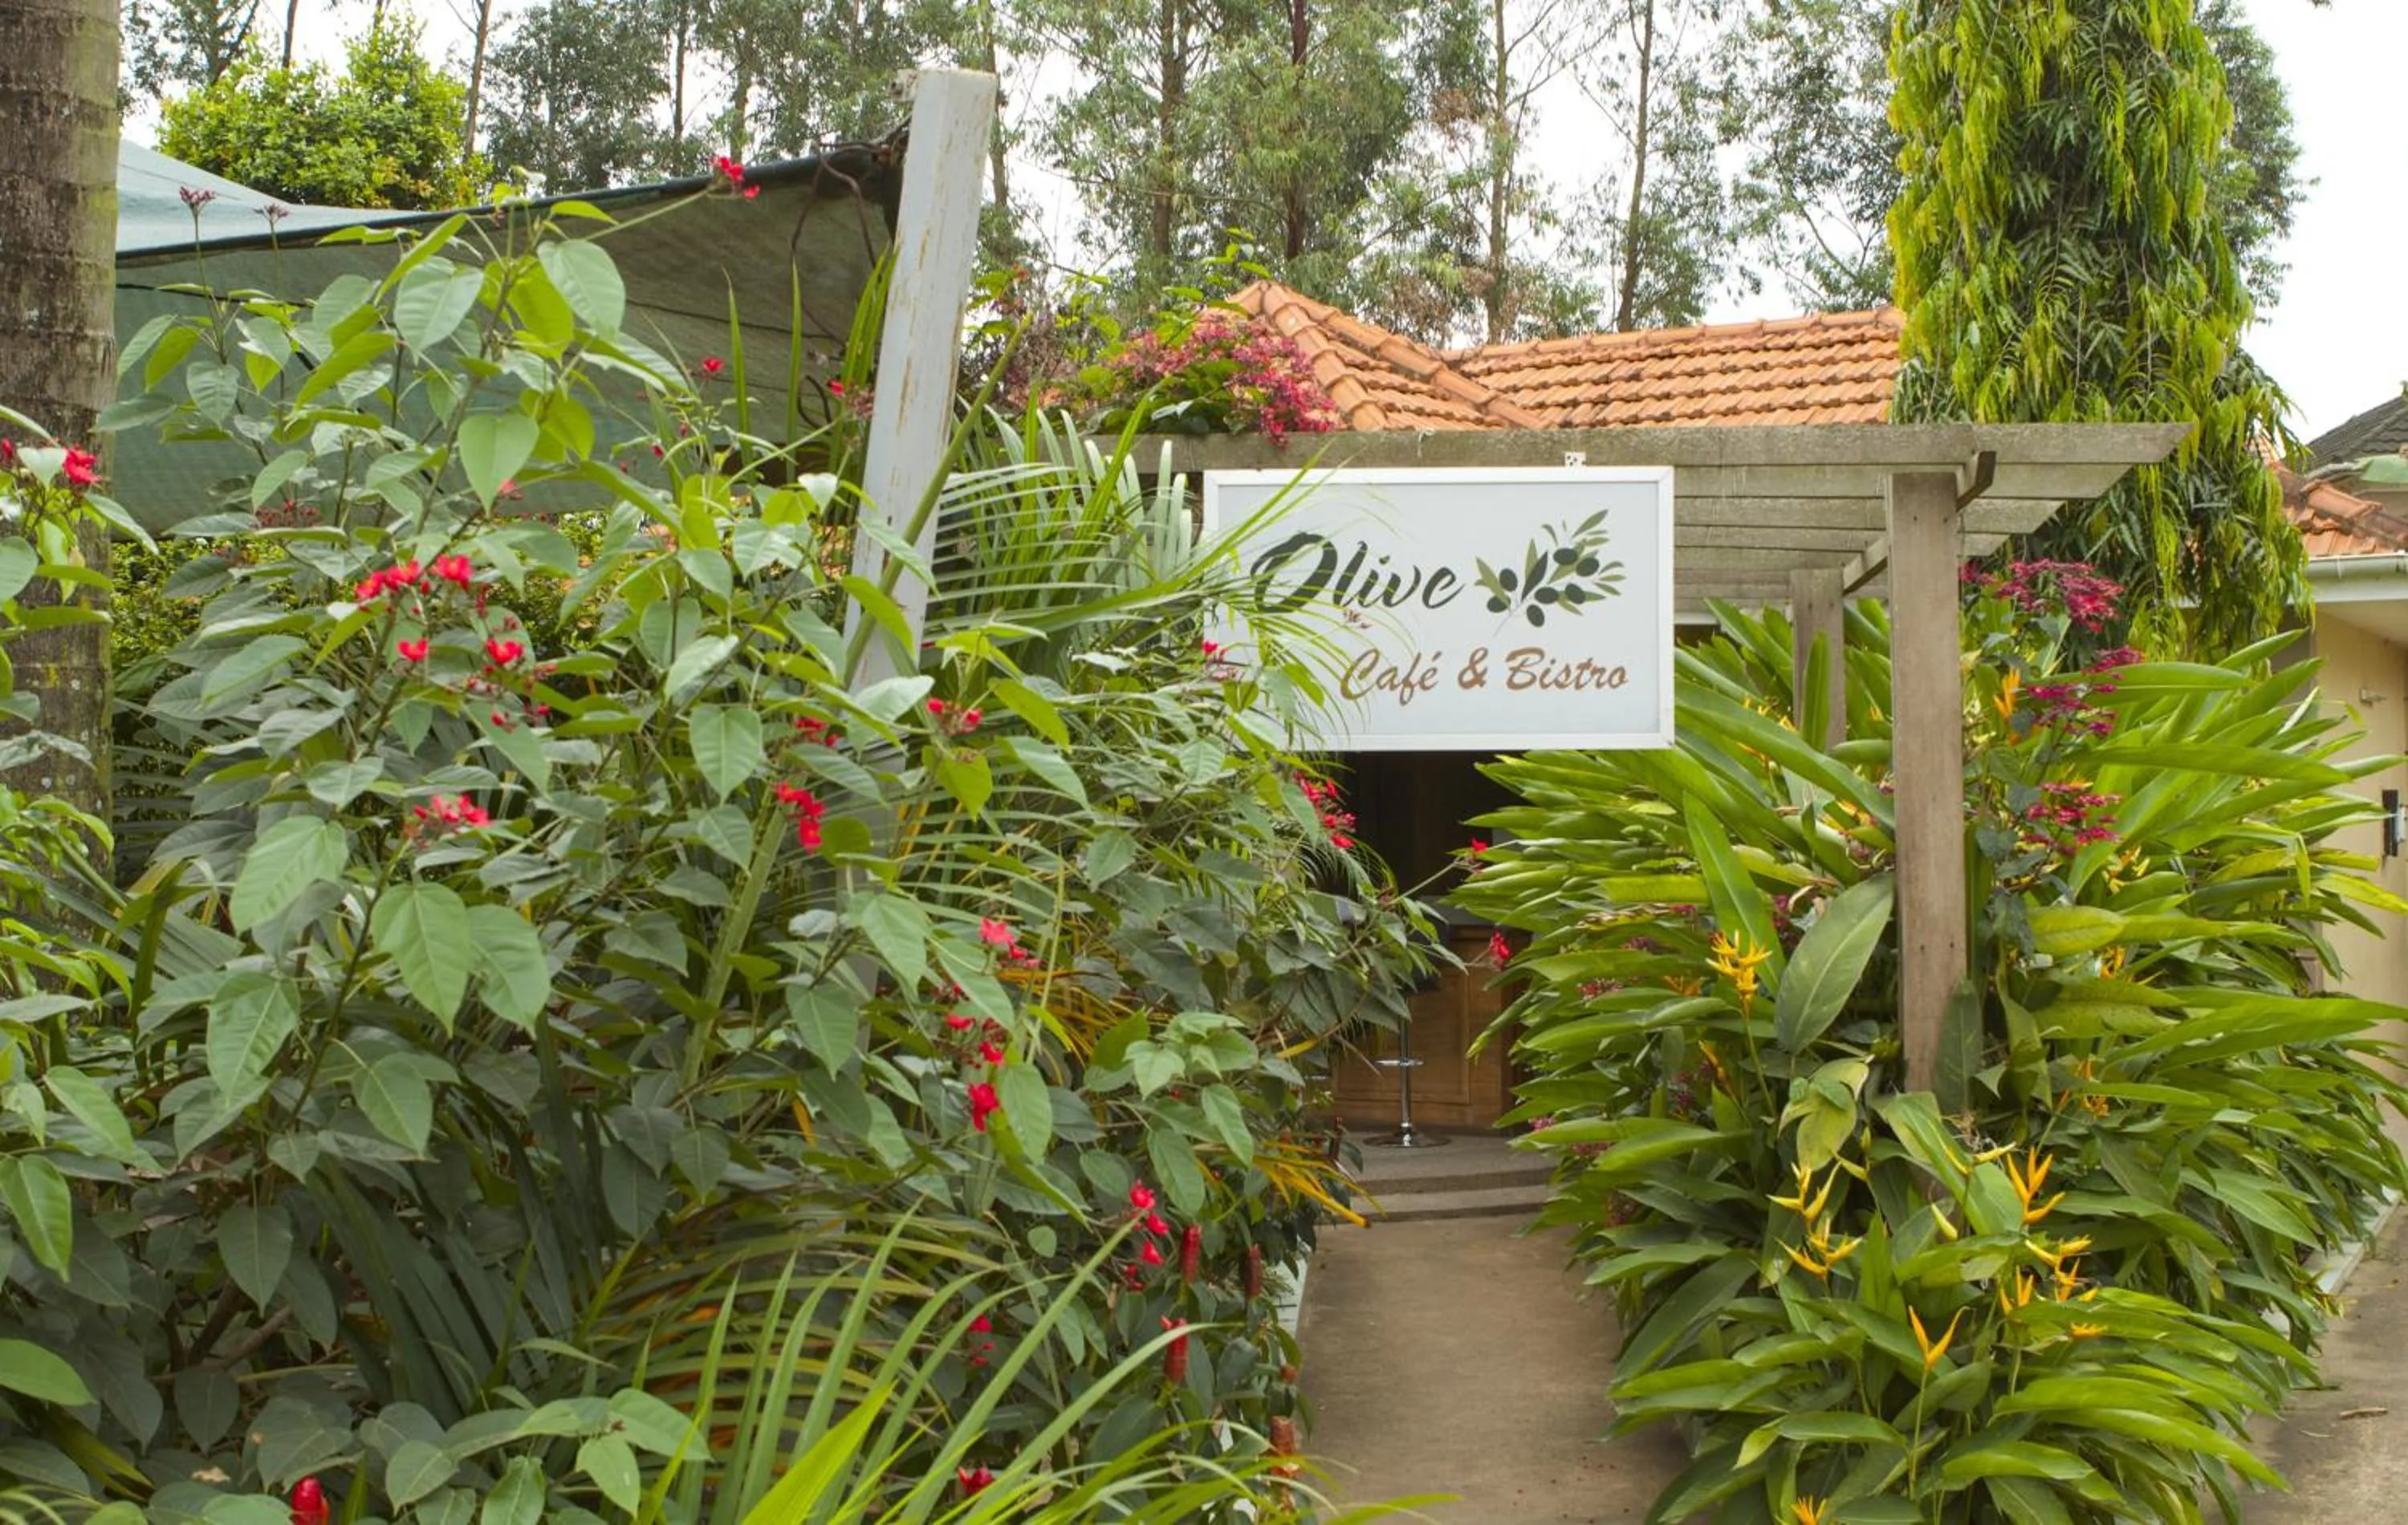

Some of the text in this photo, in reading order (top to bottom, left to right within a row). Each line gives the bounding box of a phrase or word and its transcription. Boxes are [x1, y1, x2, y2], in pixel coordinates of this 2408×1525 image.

[1250, 531, 1465, 614] Olive
[1340, 646, 1629, 706] Café & Bistro
